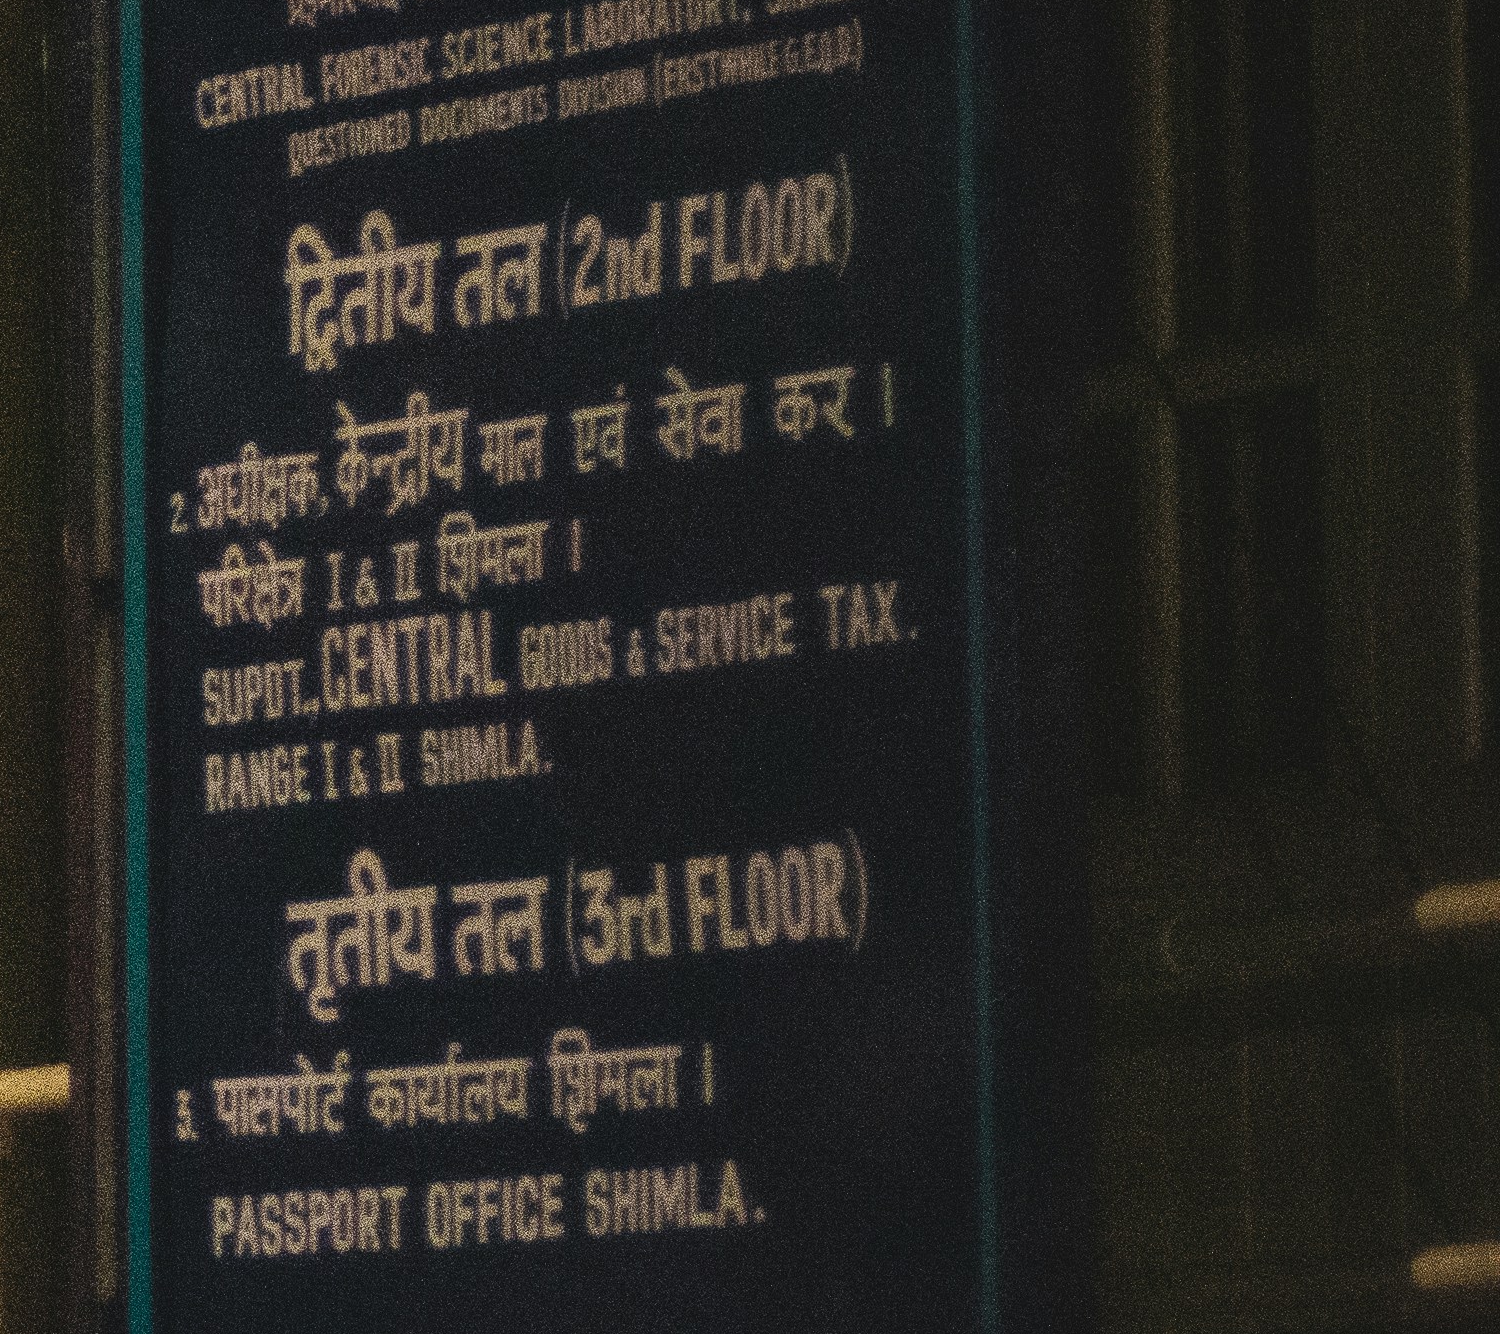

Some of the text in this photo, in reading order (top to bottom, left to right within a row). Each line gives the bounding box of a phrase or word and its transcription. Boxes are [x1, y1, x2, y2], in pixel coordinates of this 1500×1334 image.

[196, 63, 315, 130] CENTRAL
[321, 39, 433, 102] FORENSIC
[441, 12, 553, 82] SCIENCE
[288, 111, 411, 178] QUESTIONED
[418, 85, 549, 146] DOCUMENTS
[286, 153, 855, 373] द्वितीय तल (2nd FLOOR)
[334, 391, 470, 515] केन्द्रीय
[480, 413, 548, 486] माल
[572, 383, 631, 473] एवं
[656, 365, 748, 460] सेवा
[774, 365, 856, 440] कर
[436, 510, 550, 604] शिमला
[321, 609, 508, 713] CENTRAL
[520, 617, 614, 691] GOODS
[656, 591, 797, 673] SERVICE
[205, 744, 312, 814] RANGE
[285, 827, 869, 1024] तृतीय तल (3rd FLOOR)
[212, 1049, 352, 1138] पासपोर्ट
[365, 1040, 533, 1129] कार्यालय
[547, 1026, 683, 1135] शिमला
[211, 1157, 767, 1260] PASSPORT OFFICE SHIMLA.
